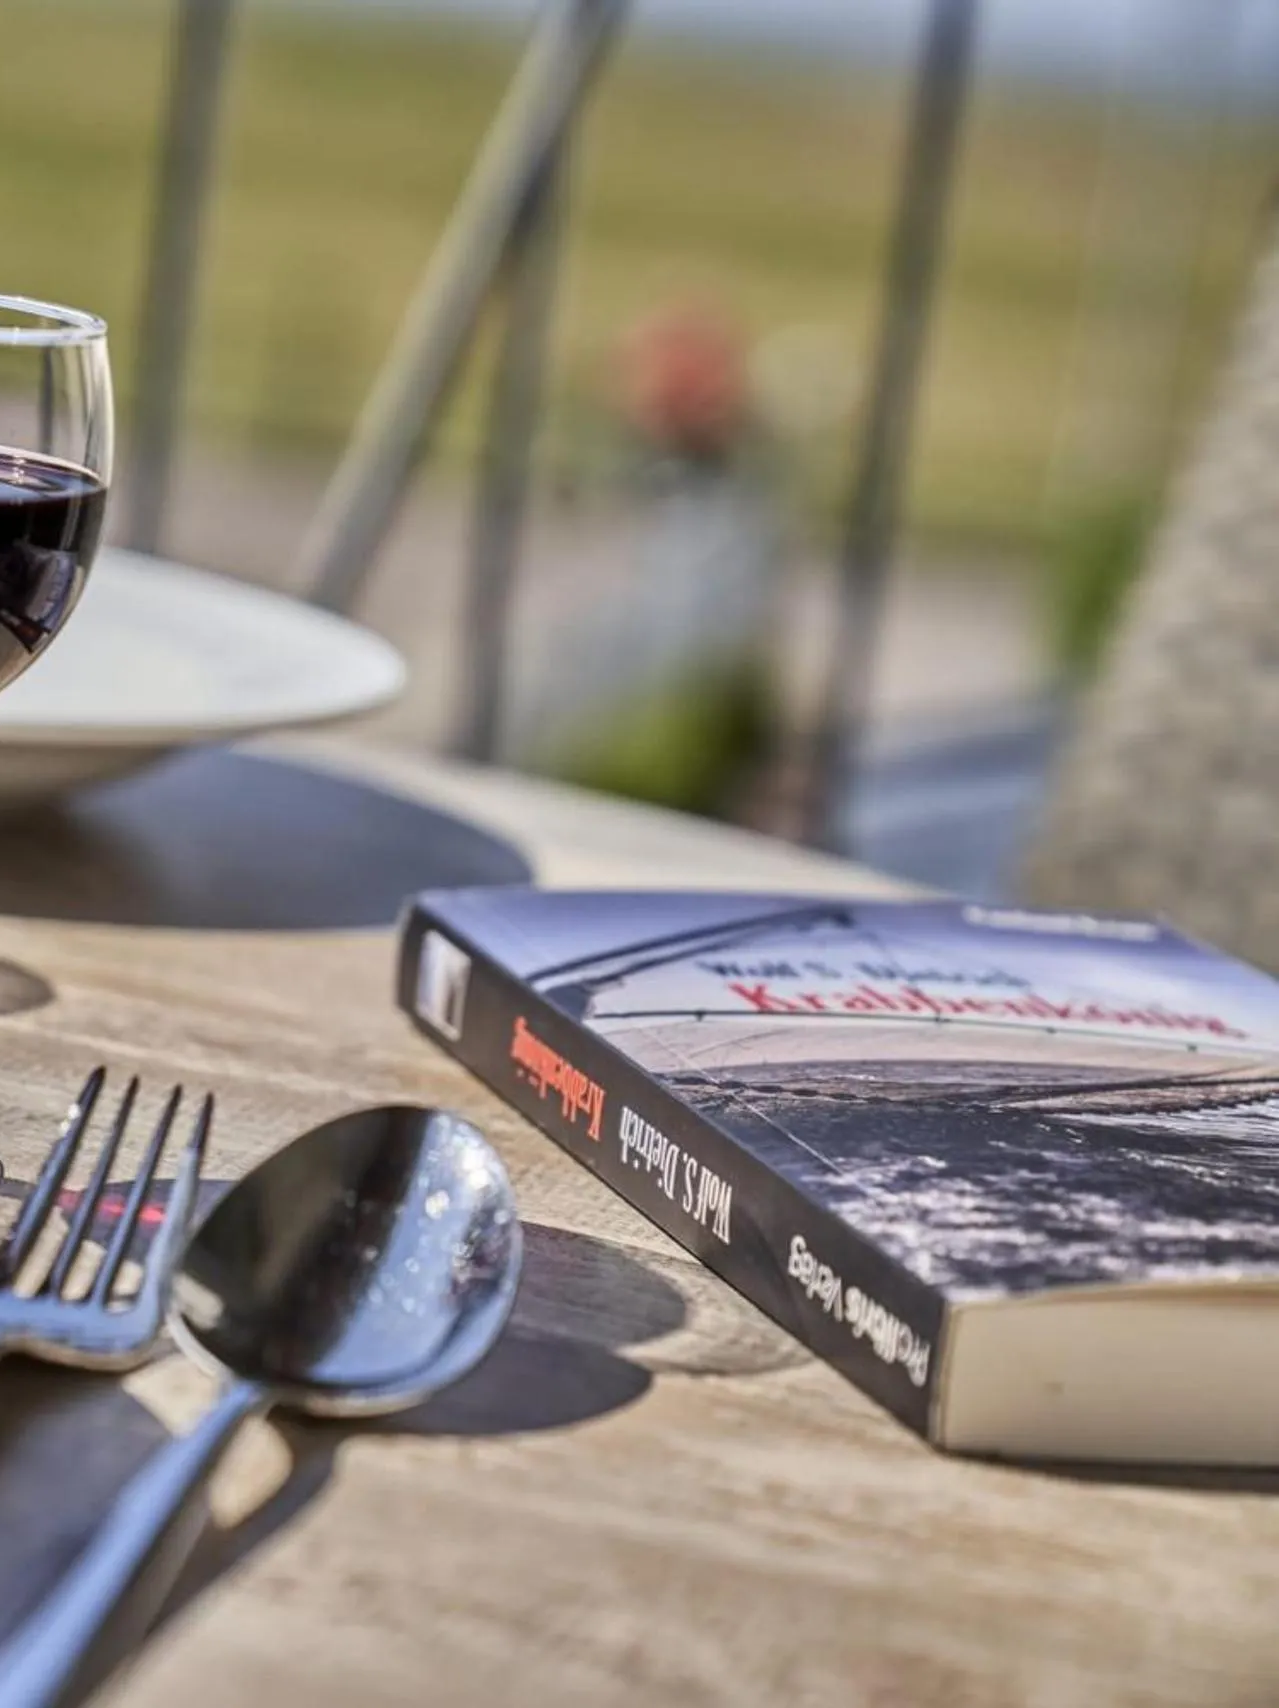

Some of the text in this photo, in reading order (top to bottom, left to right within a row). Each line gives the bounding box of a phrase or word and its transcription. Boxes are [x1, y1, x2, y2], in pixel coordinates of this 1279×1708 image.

[619, 1106, 733, 1245] Wolf S. Dietrich
[787, 1234, 843, 1323] Verlag
